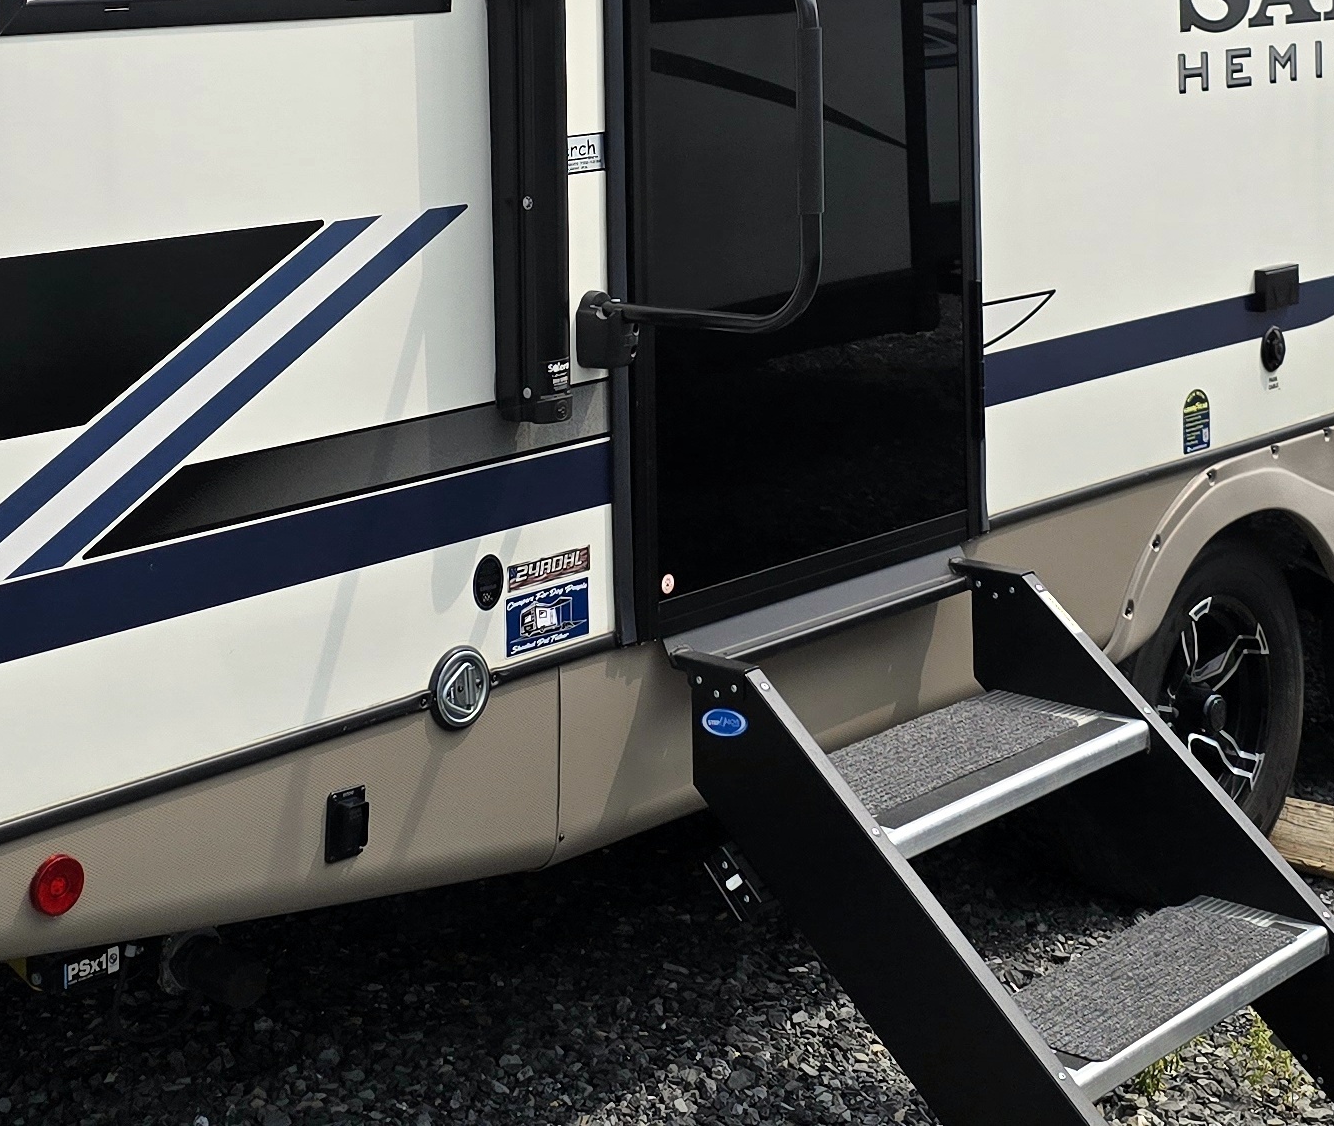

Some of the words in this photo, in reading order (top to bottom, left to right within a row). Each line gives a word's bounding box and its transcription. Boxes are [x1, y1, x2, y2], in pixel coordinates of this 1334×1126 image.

[507, 596, 534, 611] Campers
[535, 591, 549, 601] For
[549, 587, 563, 597] Dog
[565, 582, 587, 593] People
